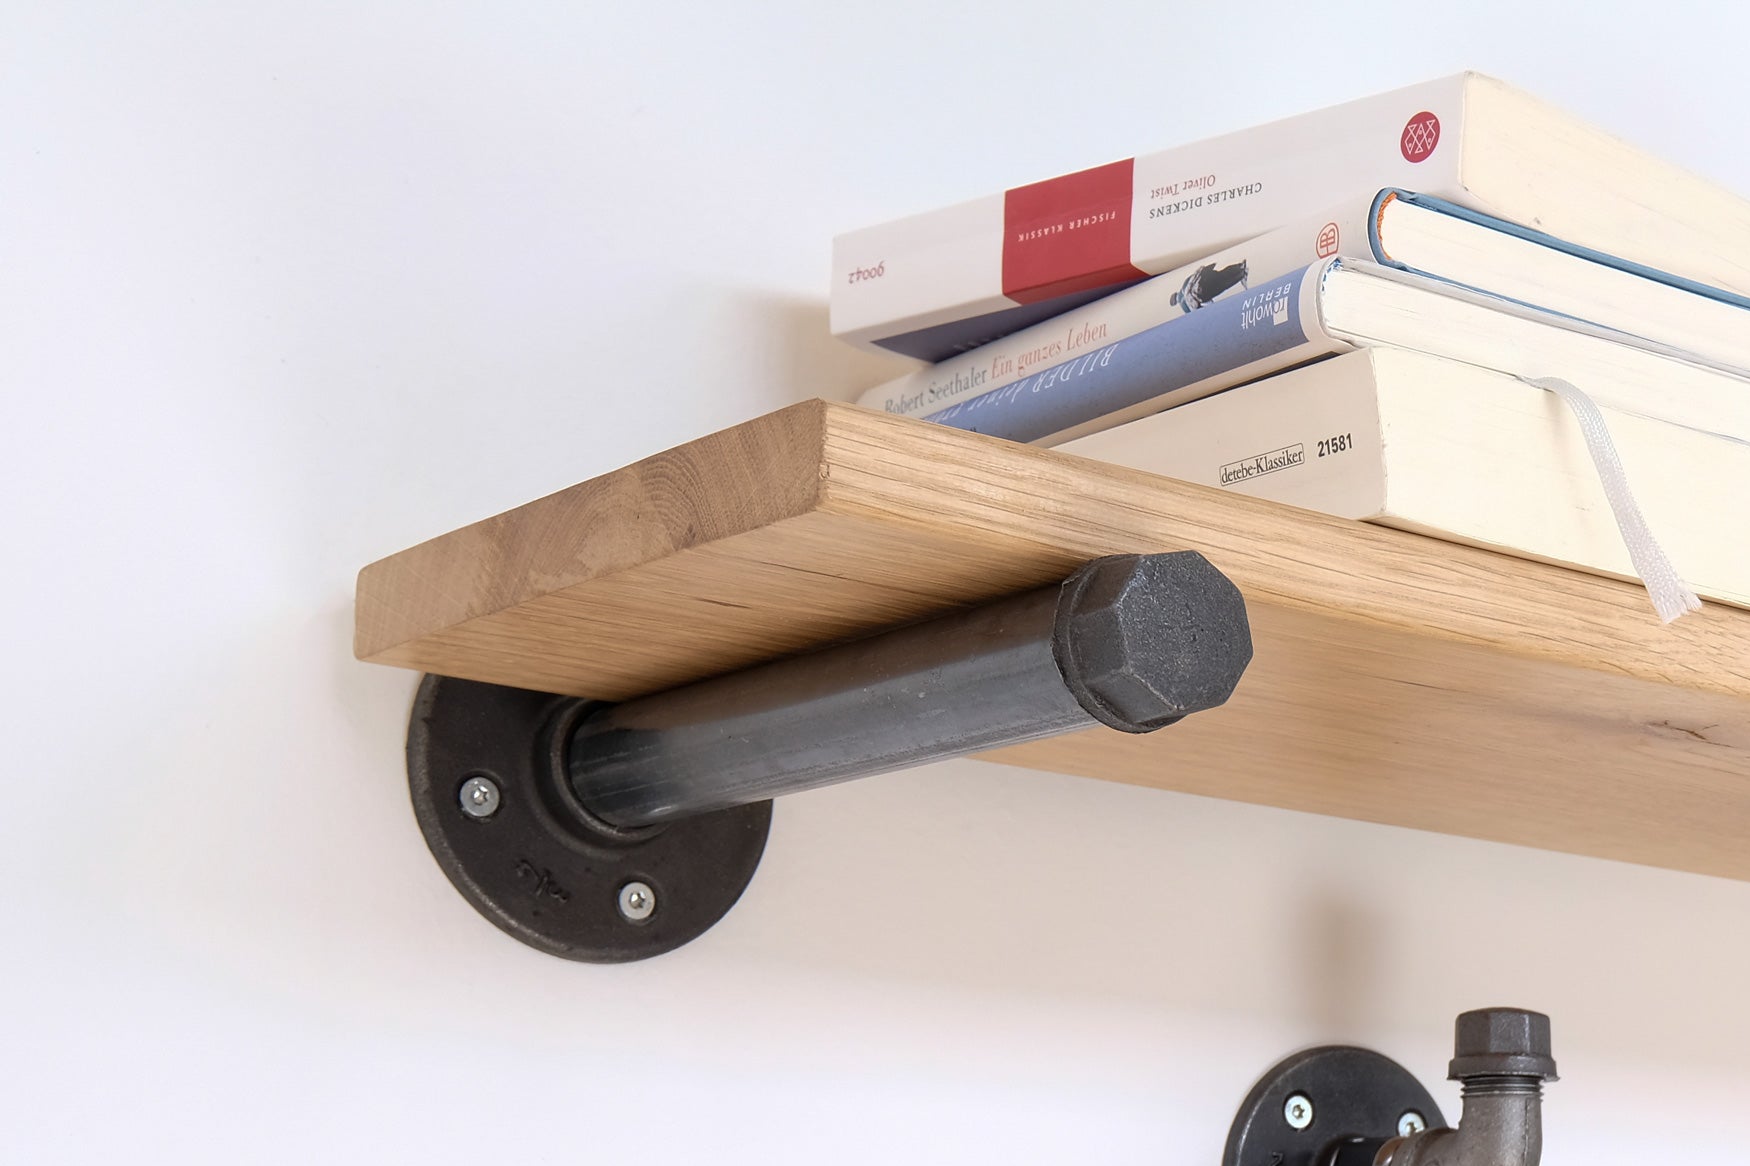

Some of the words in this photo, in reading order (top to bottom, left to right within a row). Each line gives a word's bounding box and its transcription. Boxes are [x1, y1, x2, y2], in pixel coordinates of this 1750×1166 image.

[1150, 183, 1179, 199] Twist
[1183, 174, 1216, 190] Oliver
[1207, 182, 1262, 205] CHARLES
[1149, 196, 1202, 219] DICKENS
[1069, 211, 1116, 230] FISCHER
[1018, 224, 1064, 242] KLASSIK
[847, 260, 885, 285] 90042
[1242, 282, 1291, 309] BERLIN
[1241, 296, 1289, 330] rowohlt
[885, 391, 924, 414] Robert
[928, 366, 988, 403] Seethaler
[991, 355, 1013, 380] Ein
[1017, 341, 1062, 377] ganzes
[1066, 322, 1108, 352] Leben
[1221, 449, 1304, 484] detebe-Klassiker
[1317, 433, 1352, 458] 21581
